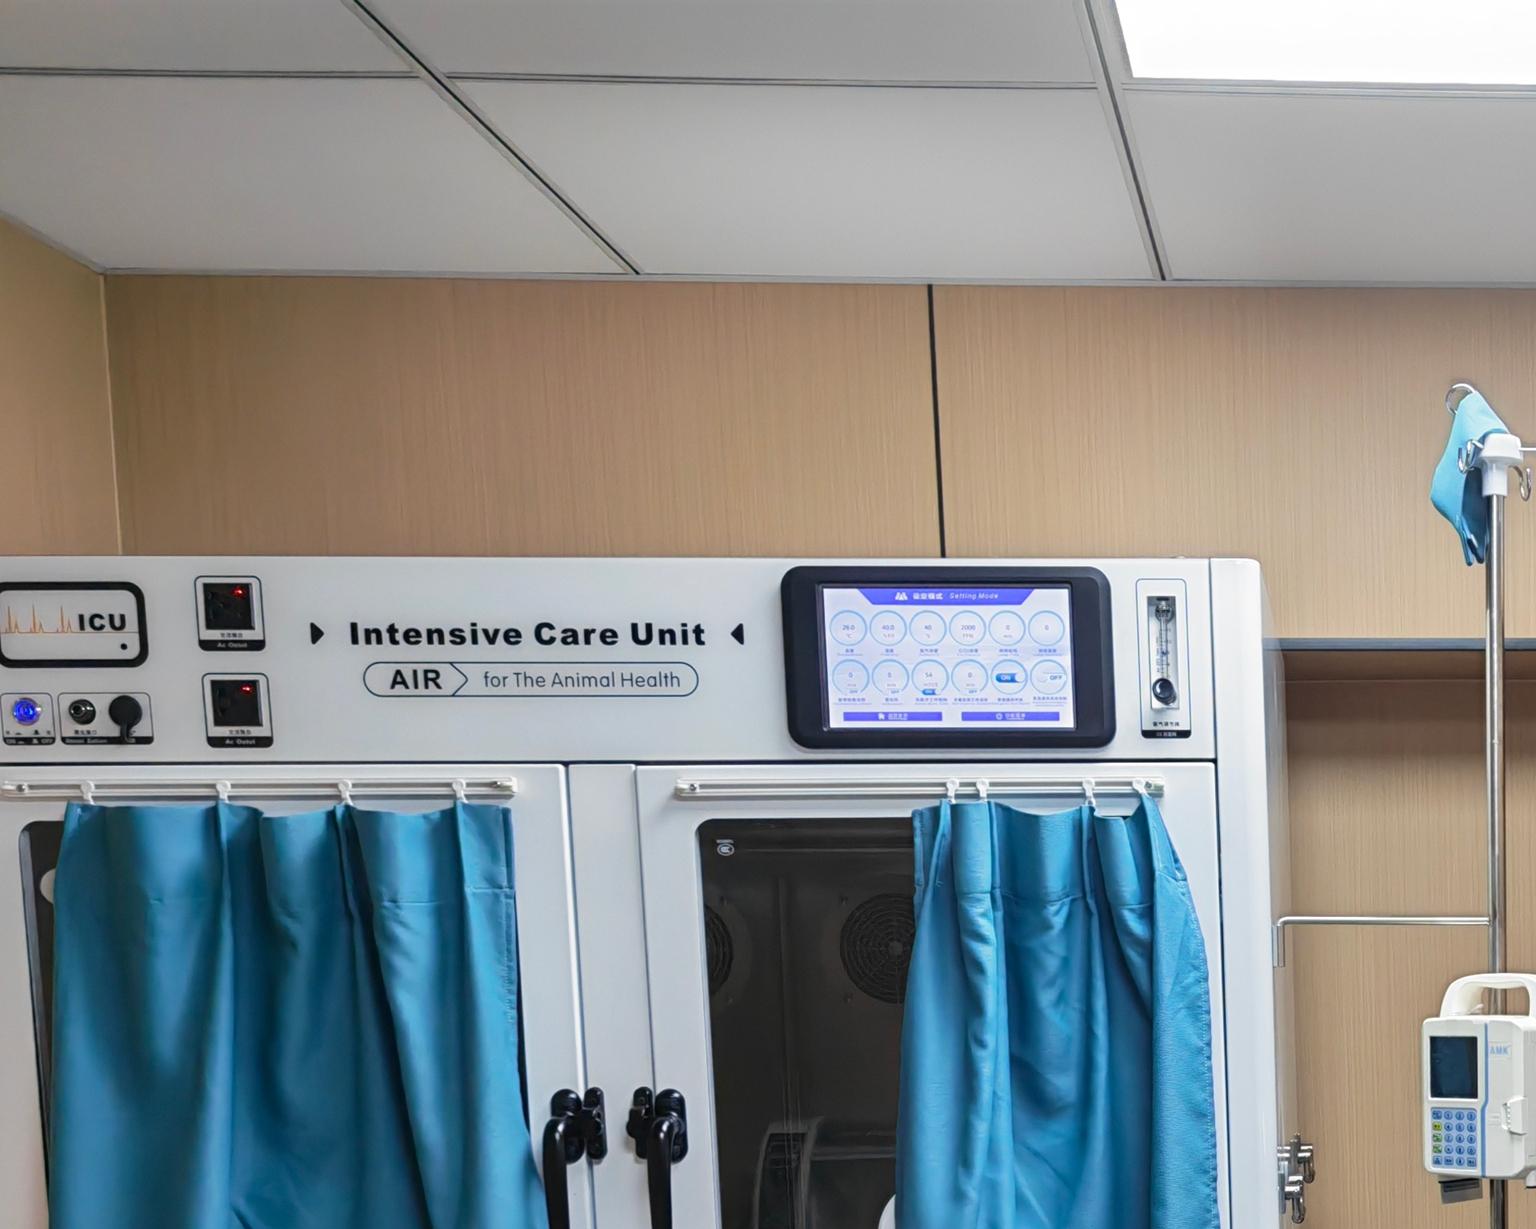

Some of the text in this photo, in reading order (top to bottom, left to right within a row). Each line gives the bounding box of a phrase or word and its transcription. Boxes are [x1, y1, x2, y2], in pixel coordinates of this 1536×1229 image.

[78, 613, 127, 631] ICU
[350, 622, 706, 646] Intensive Care Unit
[389, 669, 442, 690] AIR
[484, 671, 680, 688] for The Animal Health
